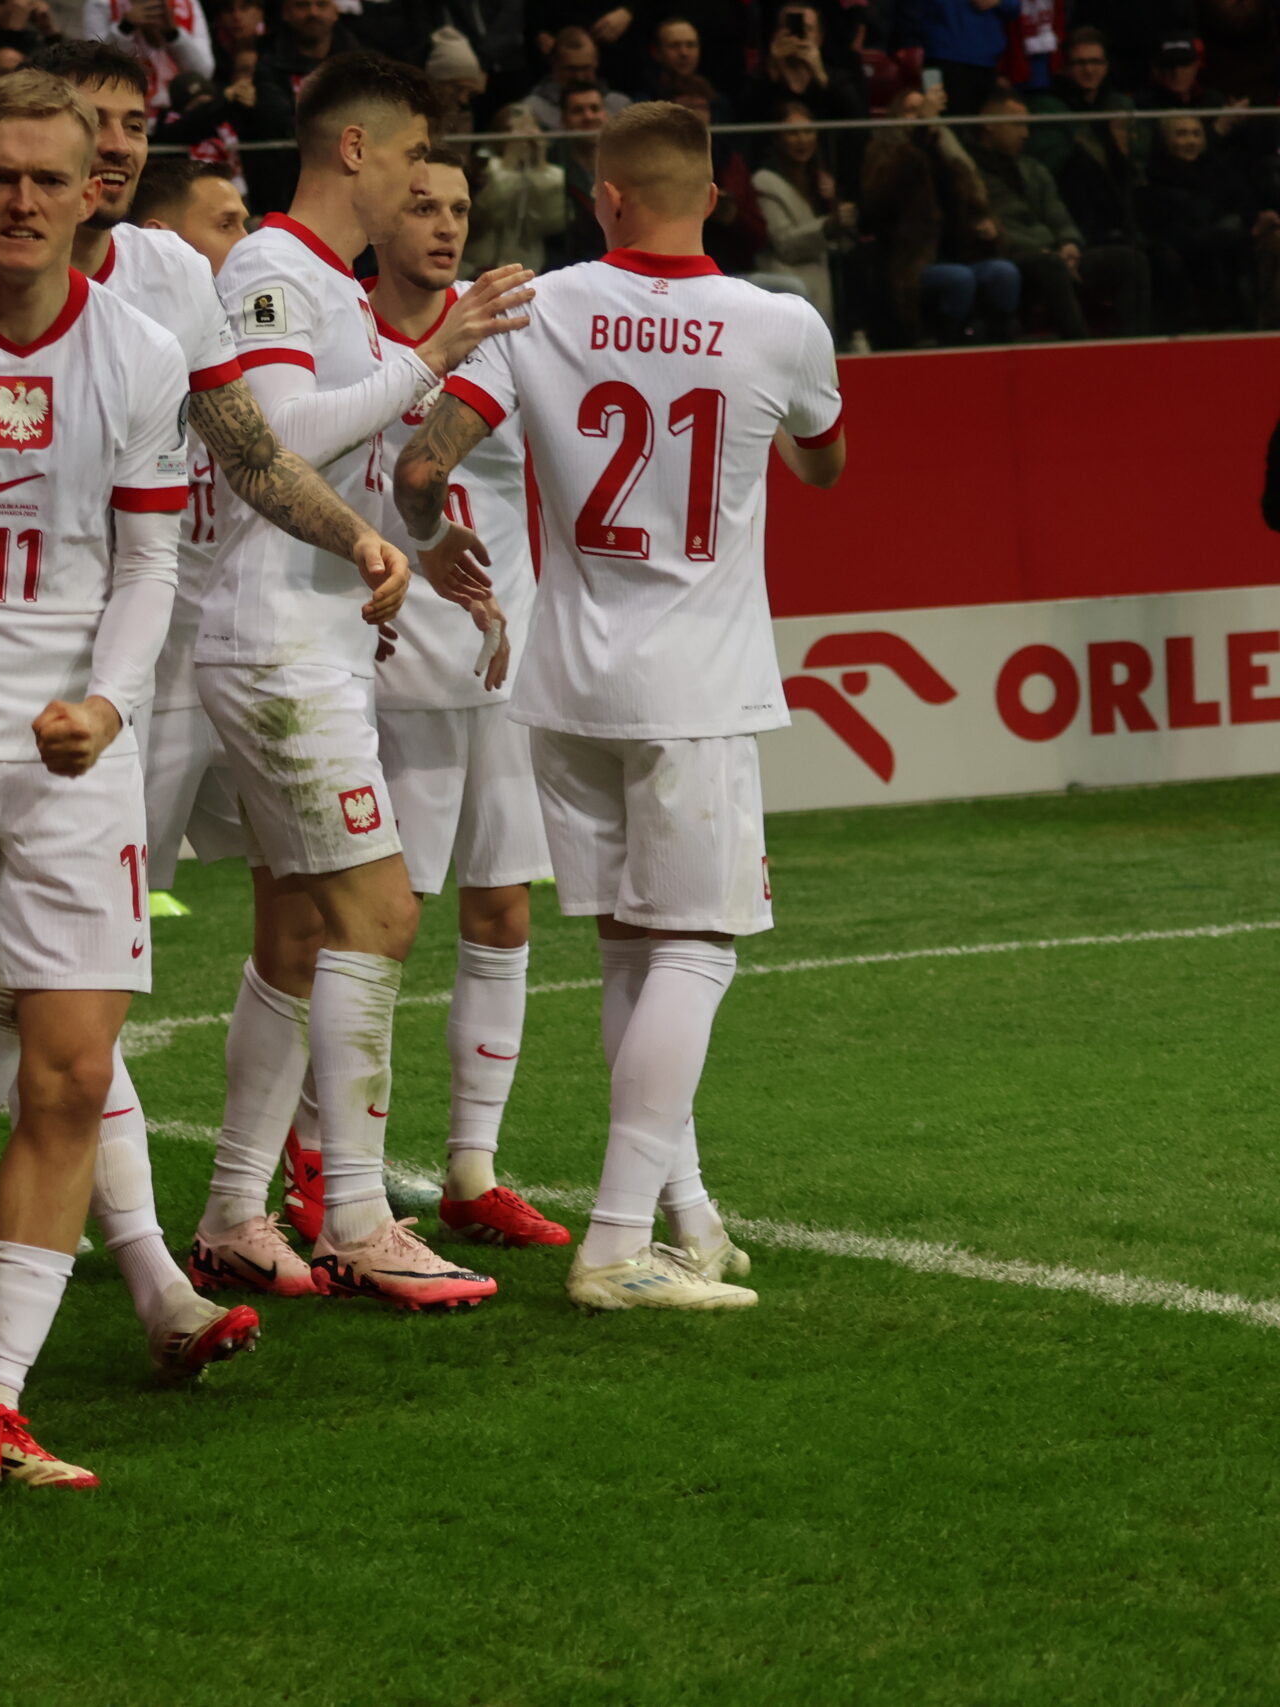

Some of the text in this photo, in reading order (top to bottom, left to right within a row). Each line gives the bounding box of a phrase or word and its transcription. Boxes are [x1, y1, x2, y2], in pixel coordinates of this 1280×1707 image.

[590, 314, 725, 357] BOGUSZ
[575, 380, 726, 561] 21
[995, 630, 1280, 742] ORLE
